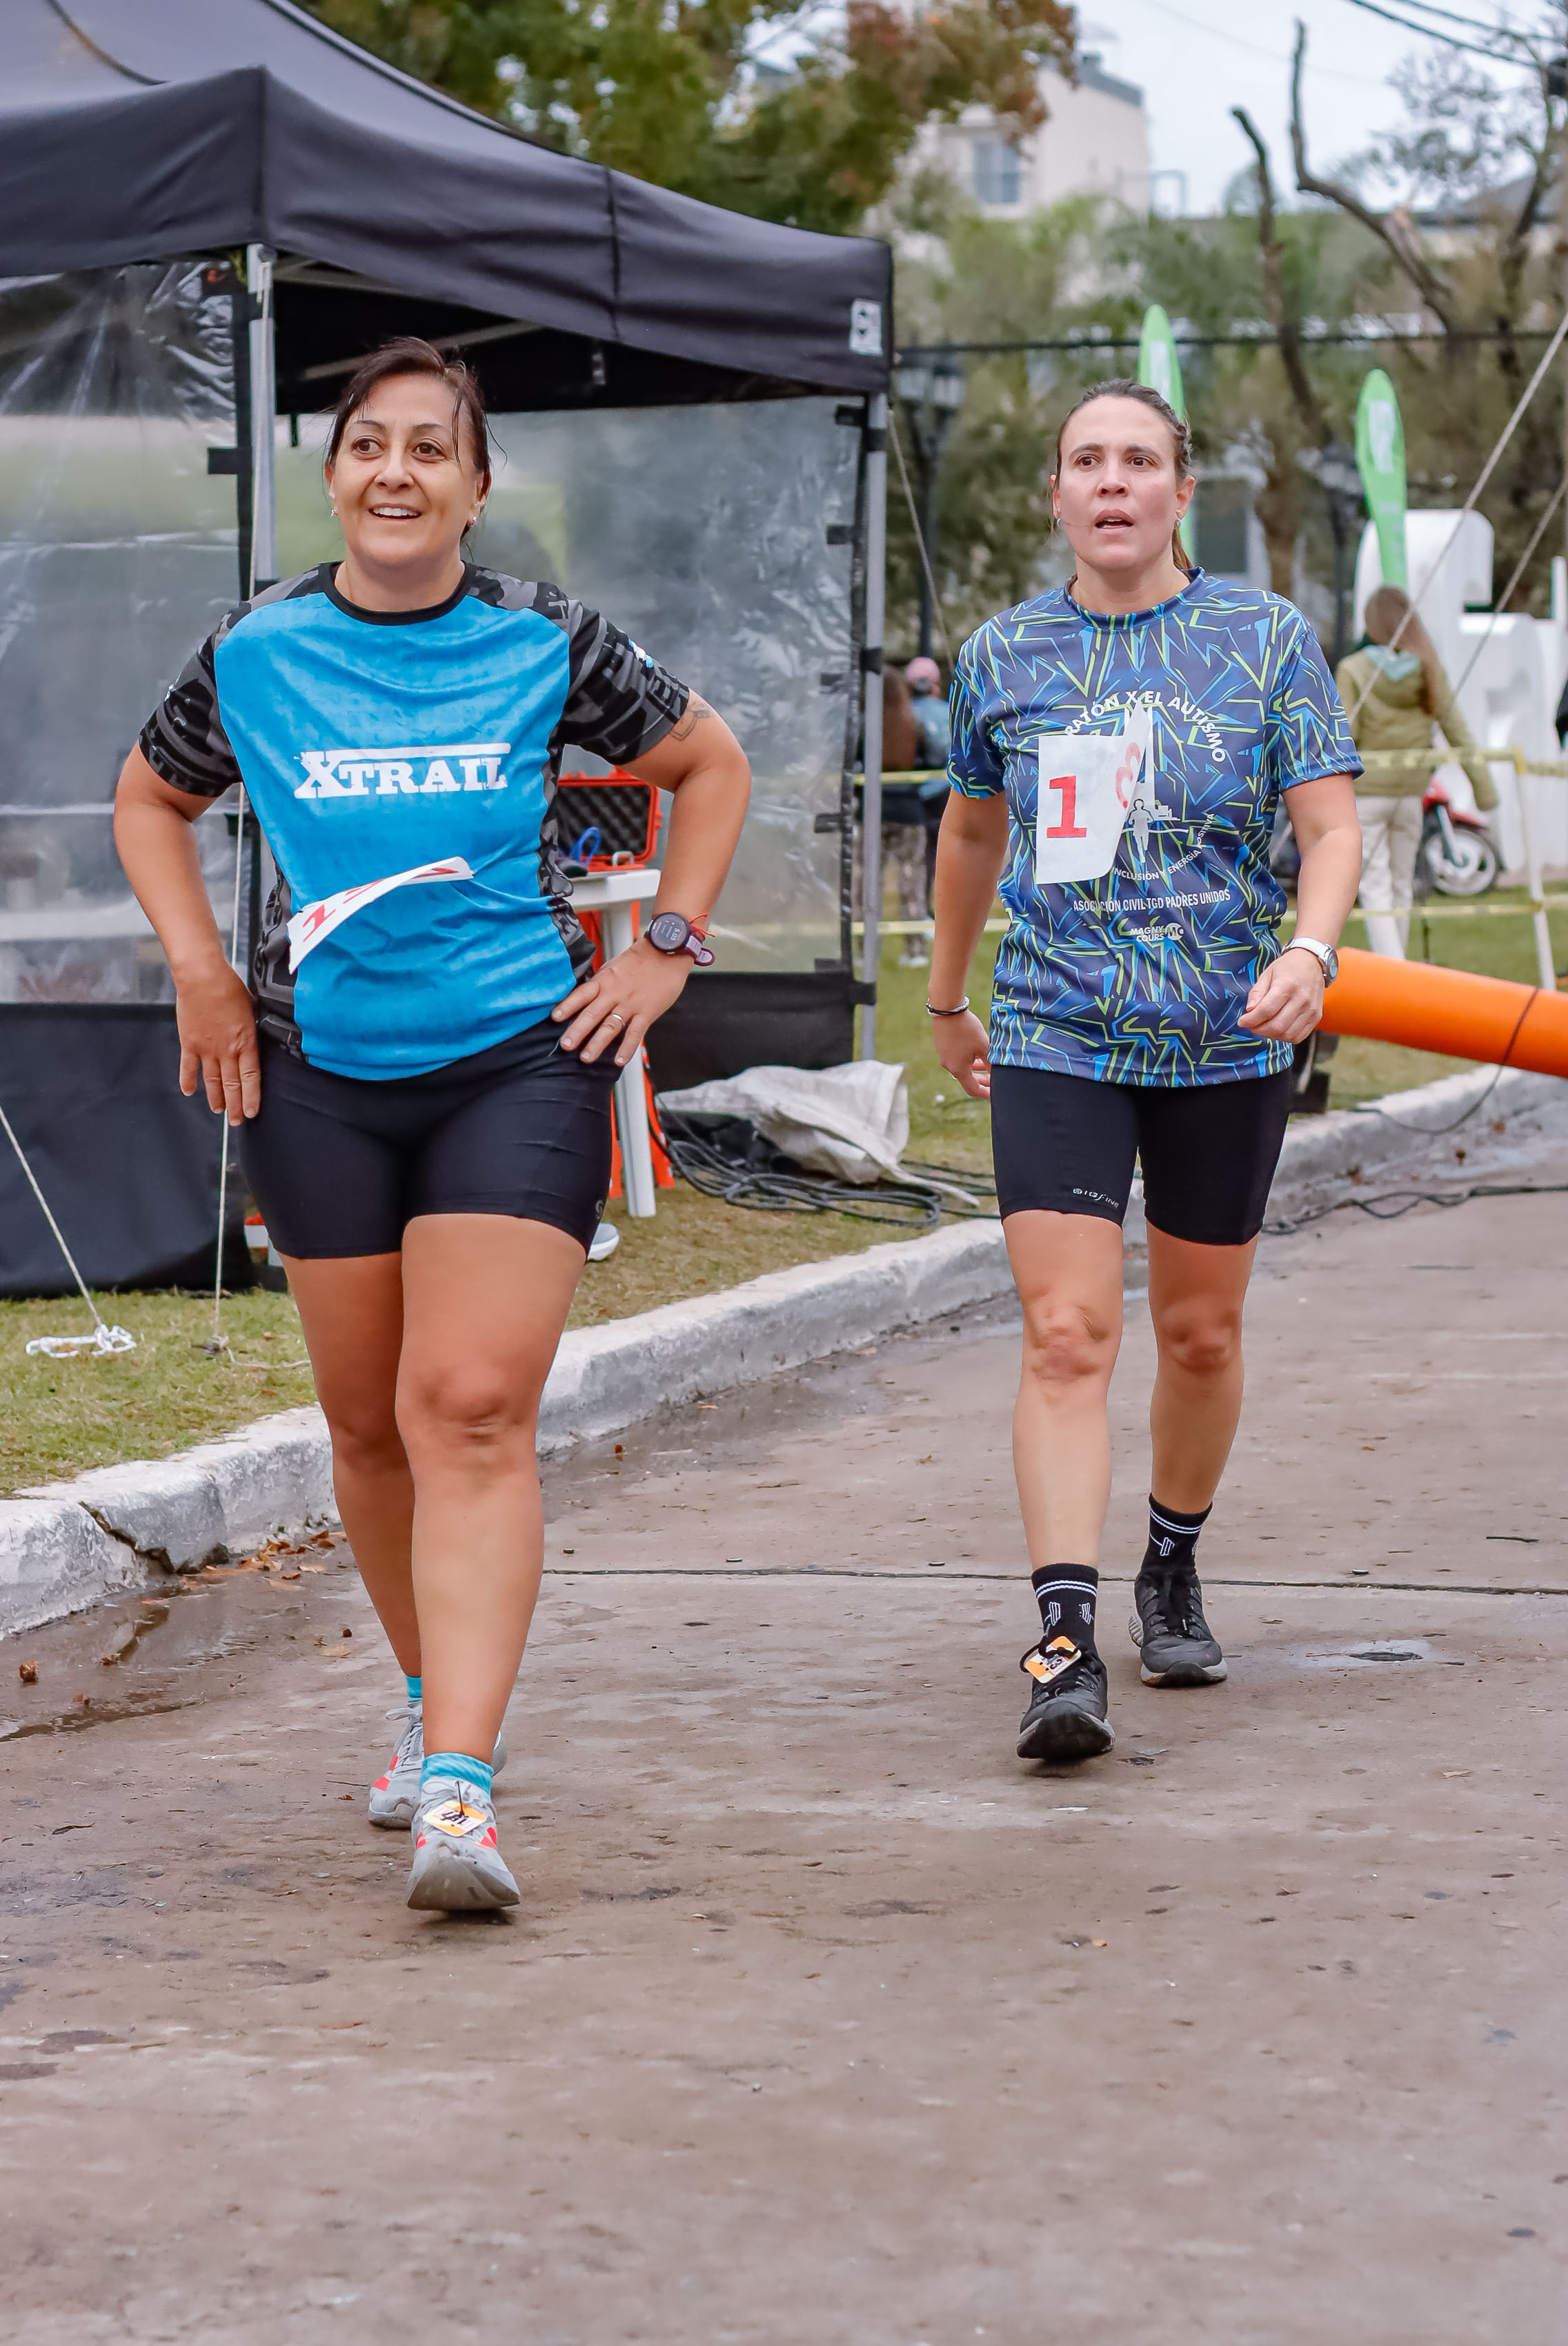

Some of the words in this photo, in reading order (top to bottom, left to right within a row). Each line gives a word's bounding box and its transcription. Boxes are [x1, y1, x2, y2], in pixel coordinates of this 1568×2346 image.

[1126, 690, 1139, 704] X
[1144, 690, 1163, 704] EL
[1167, 696, 1226, 762] AUTISMO
[293, 743, 511, 799] XTRAIL
[1167, 849, 1202, 875] ENERGÍA
[1196, 813, 1215, 849] POSITIVA
[1073, 897, 1121, 912] ASOCIACIÓN
[1122, 898, 1146, 911] CIVIL
[1147, 897, 1164, 909] TGD
[1166, 893, 1199, 908] PADRES
[1200, 888, 1231, 904] UNIDOS
[1130, 925, 1164, 935] MAGNY
[1136, 933, 1164, 942] COURS
